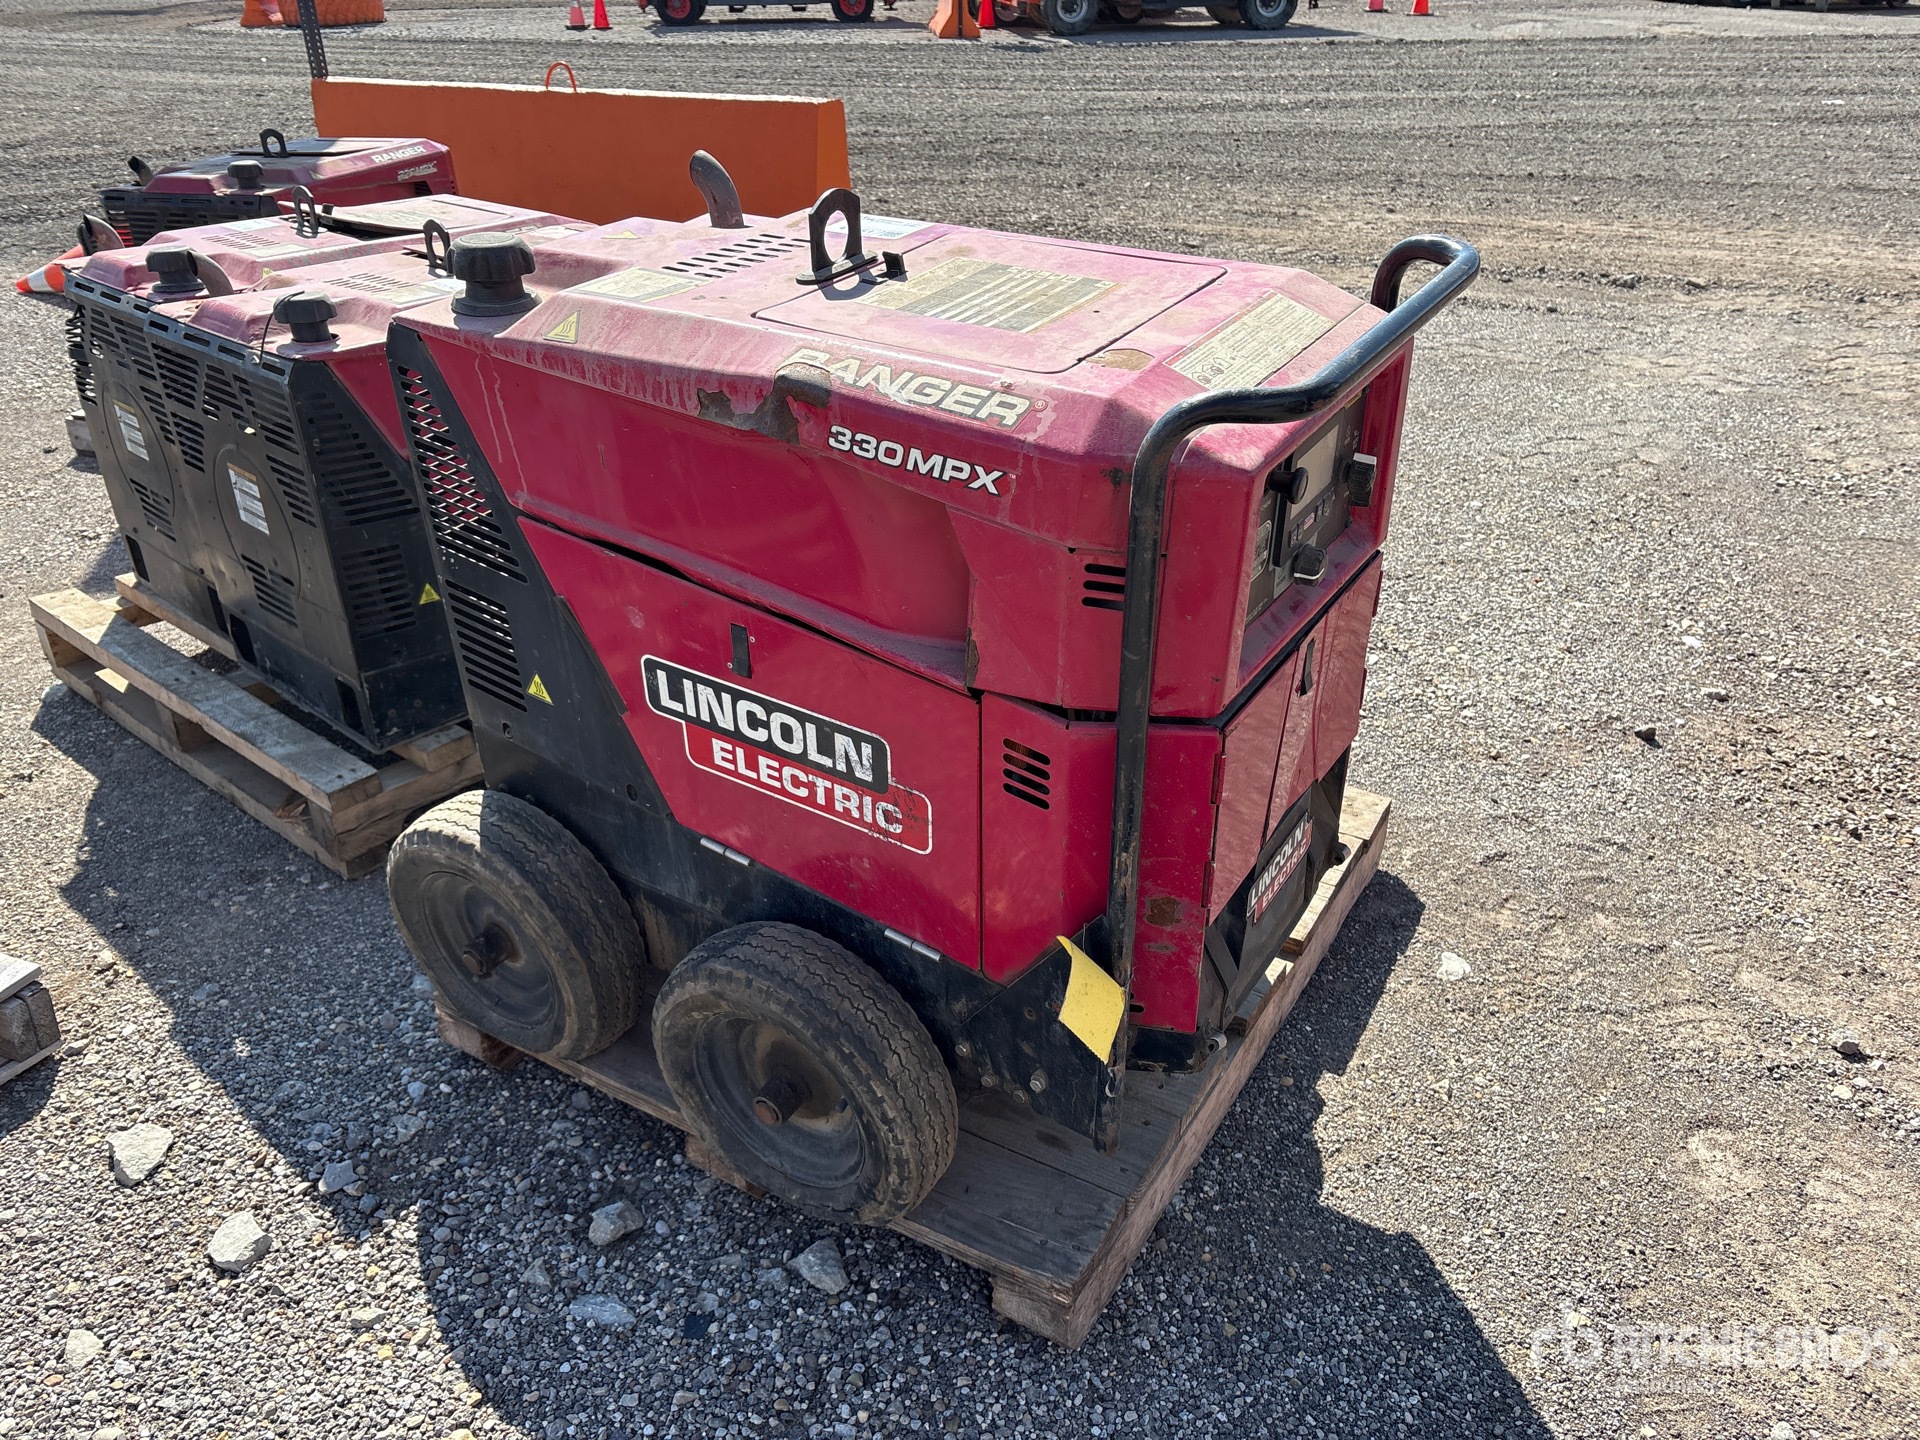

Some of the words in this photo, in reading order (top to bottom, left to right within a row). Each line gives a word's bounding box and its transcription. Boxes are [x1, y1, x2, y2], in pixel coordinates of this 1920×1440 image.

[371, 145, 427, 164] RANGER
[656, 669, 873, 783] LINCOLN
[712, 737, 904, 834] ELECTRIC
[1251, 821, 1304, 908] LINCOLN
